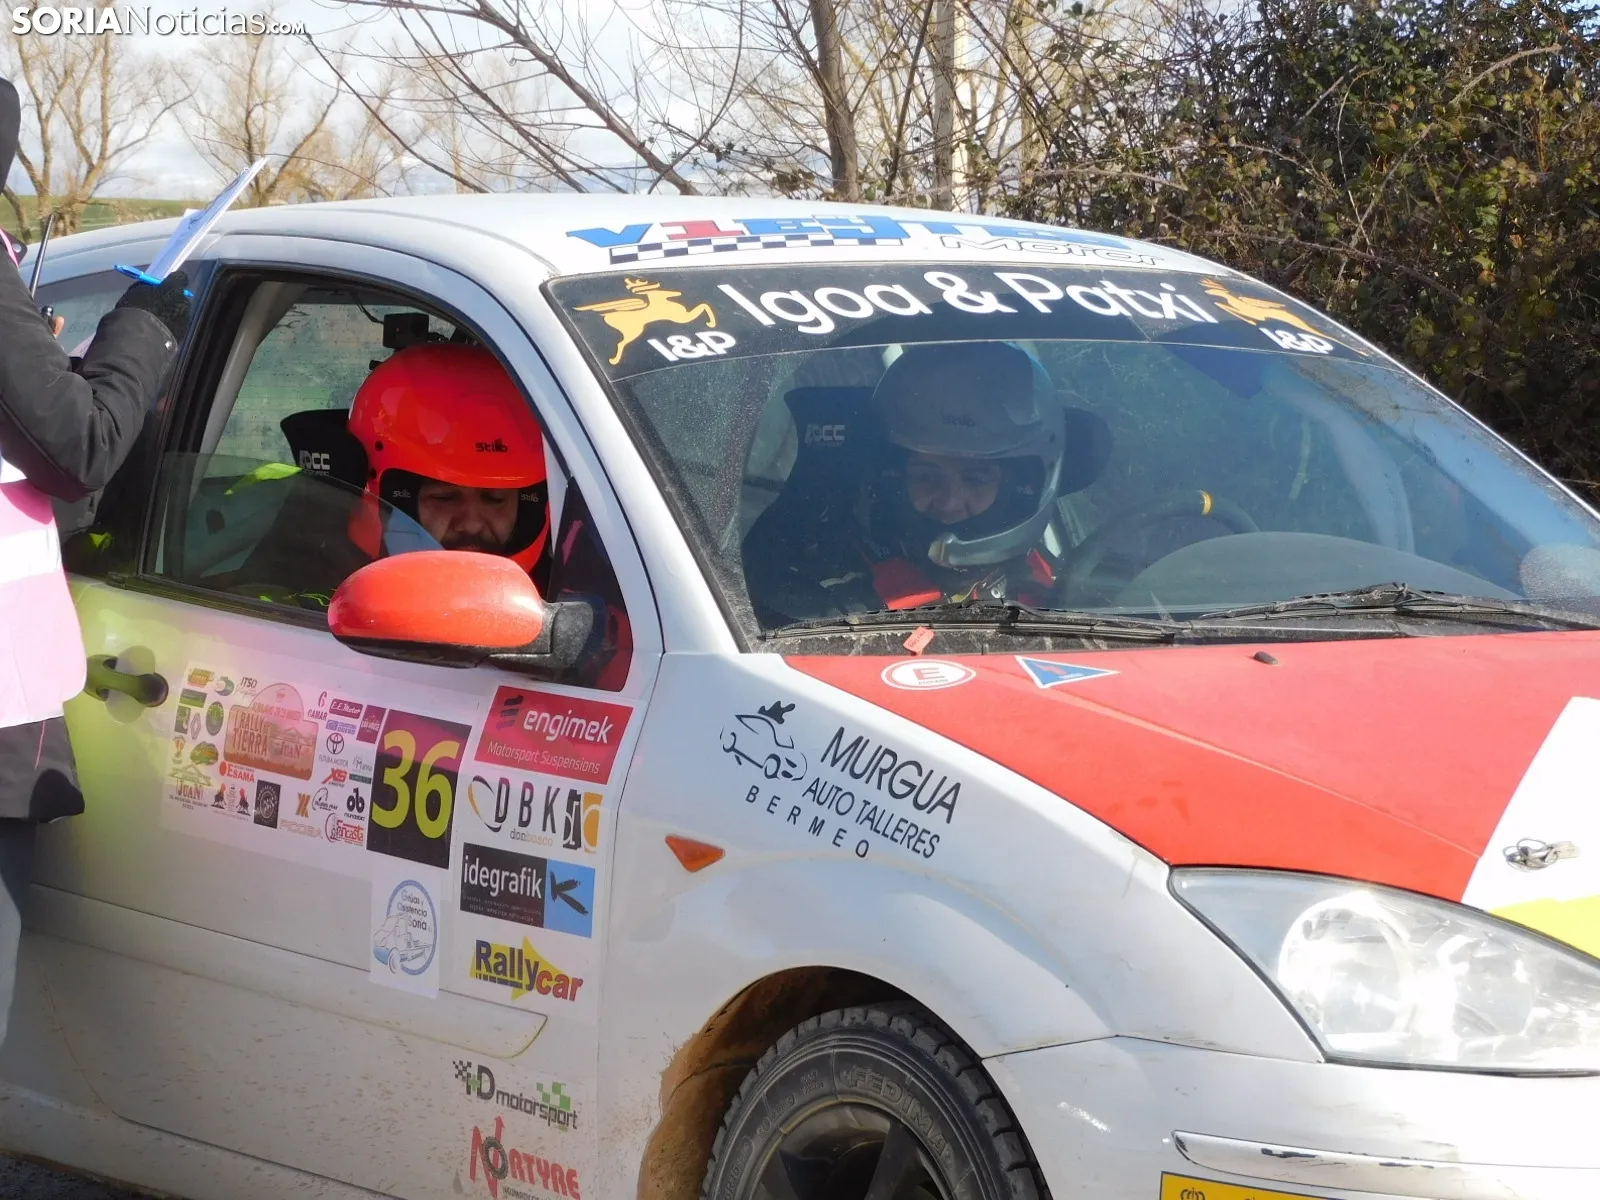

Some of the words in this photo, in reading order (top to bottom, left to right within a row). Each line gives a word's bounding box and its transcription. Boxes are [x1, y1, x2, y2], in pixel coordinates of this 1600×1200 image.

[717, 283, 933, 335] Igoa
[923, 270, 1018, 315] &
[993, 271, 1220, 324] Patxi
[232, 728, 268, 757] TIERRA
[239, 711, 265, 733] RALLY
[522, 710, 615, 745] engimek
[370, 729, 461, 840] 36
[487, 740, 540, 762] Motorsport
[539, 750, 601, 774] Suspensions
[820, 726, 962, 824] MURGUA
[494, 776, 561, 834] DBK
[745, 785, 870, 859] BERMEO
[802, 777, 855, 816] AUTO
[855, 799, 940, 859] TALLERES
[463, 855, 543, 900] idegrafik
[475, 939, 584, 1002] Rallycar
[495, 1089, 578, 1130] motorsport
